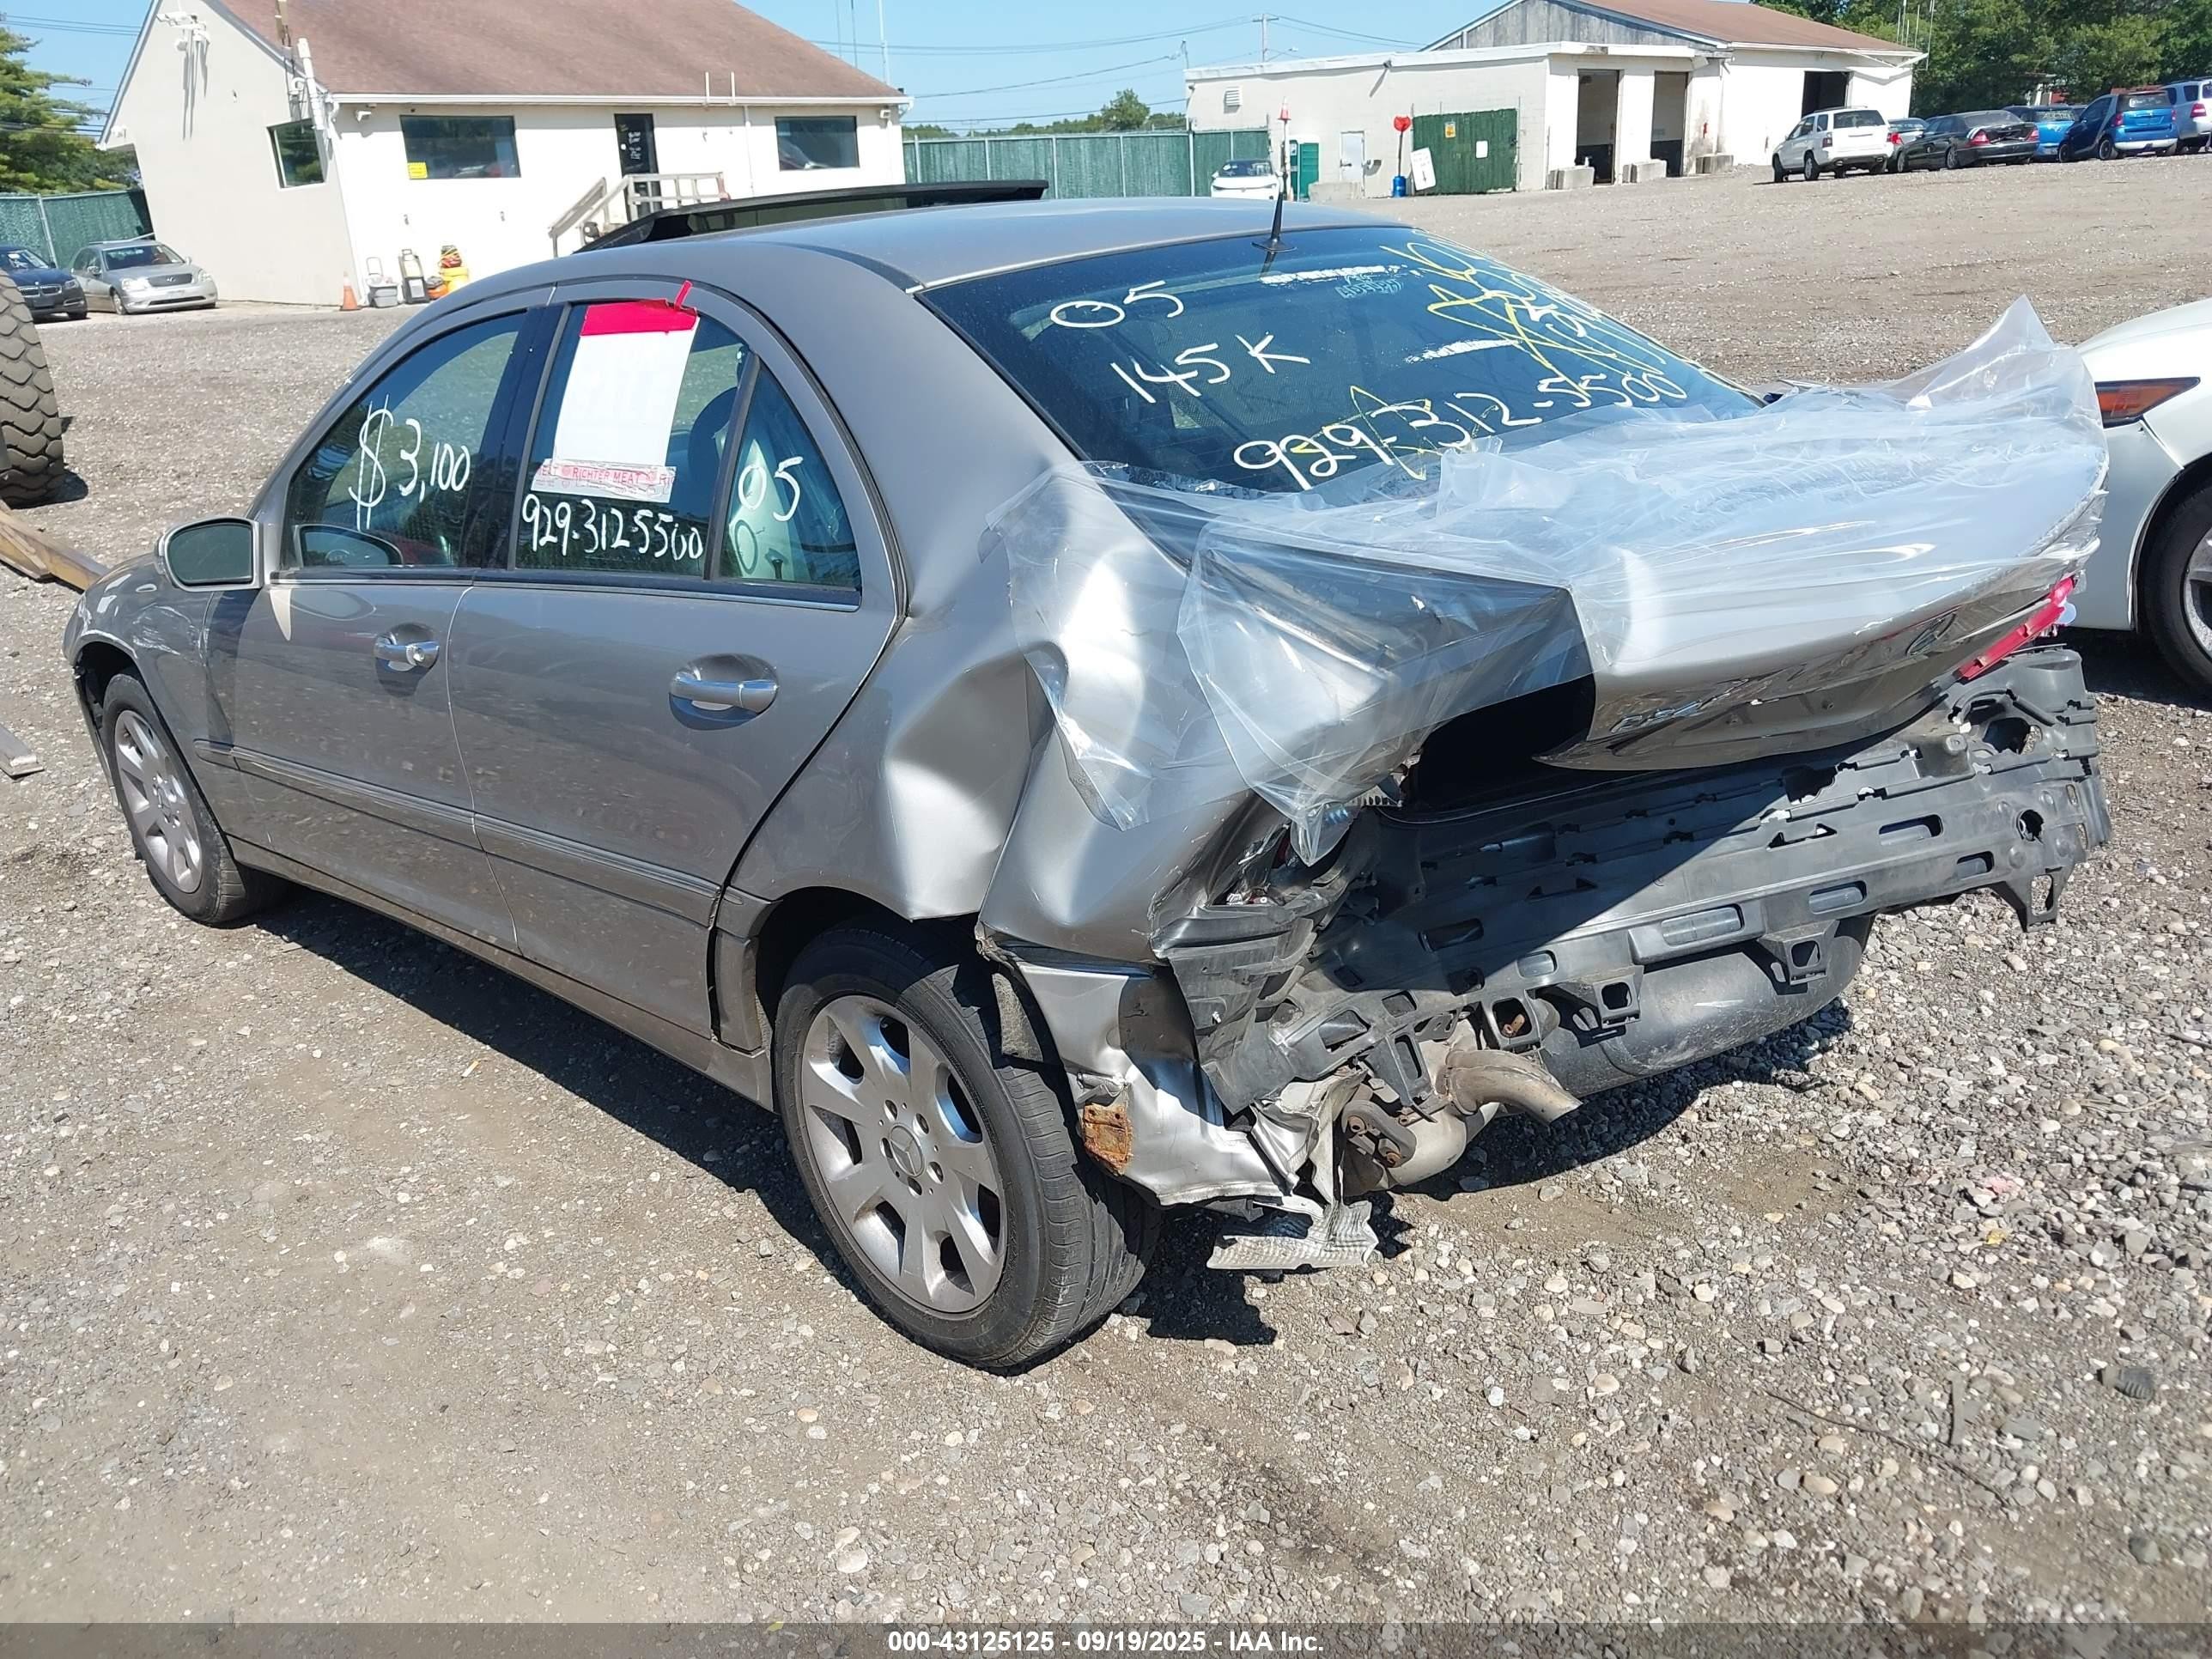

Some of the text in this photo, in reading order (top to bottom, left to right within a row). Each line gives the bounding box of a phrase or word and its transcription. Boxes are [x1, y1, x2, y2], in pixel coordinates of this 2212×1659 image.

[1050, 280, 1184, 328] 05
[1235, 331, 1311, 374] K
[573, 468, 610, 480] RICHTER
[614, 472, 641, 484] MEAT
[738, 456, 804, 521] 05
